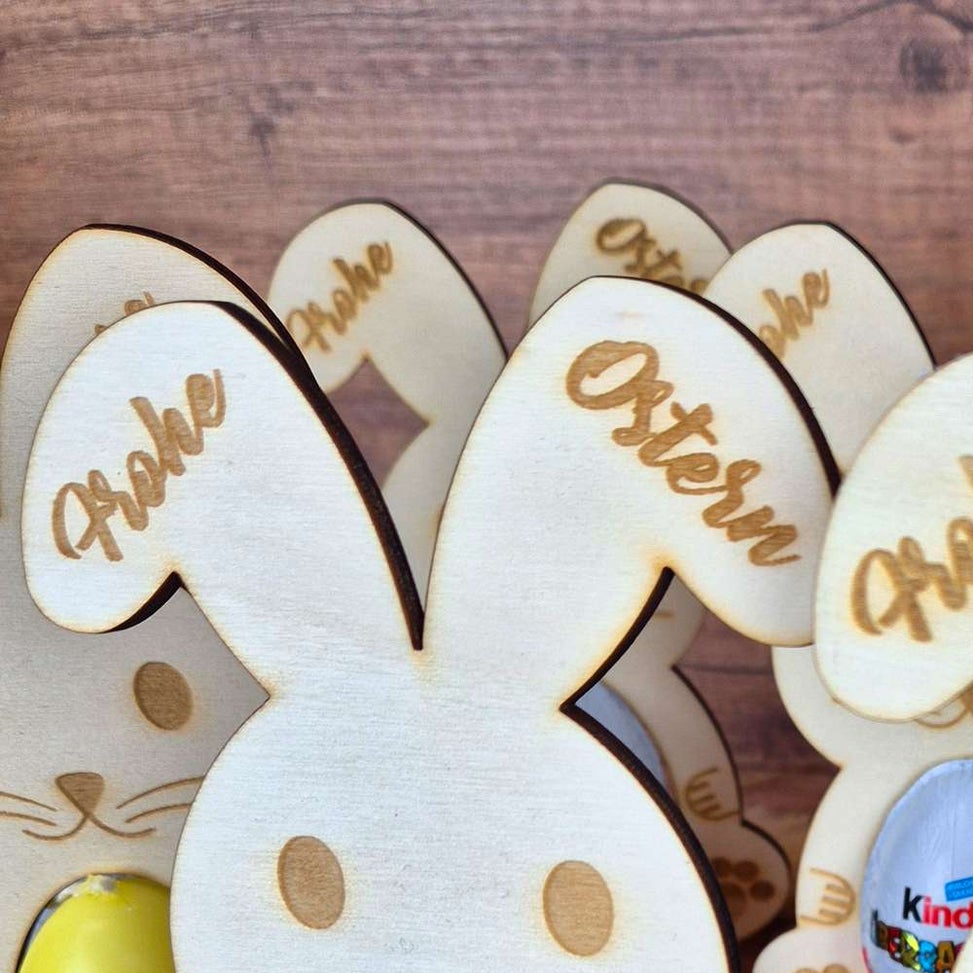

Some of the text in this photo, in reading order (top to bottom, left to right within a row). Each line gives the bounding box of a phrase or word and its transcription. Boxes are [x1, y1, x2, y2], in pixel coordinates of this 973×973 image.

[286, 241, 393, 353] Frohe
[597, 218, 710, 293] Ost
[759, 268, 830, 358] ohe
[52, 369, 225, 561] Frohe
[566, 341, 800, 566] Ostern
